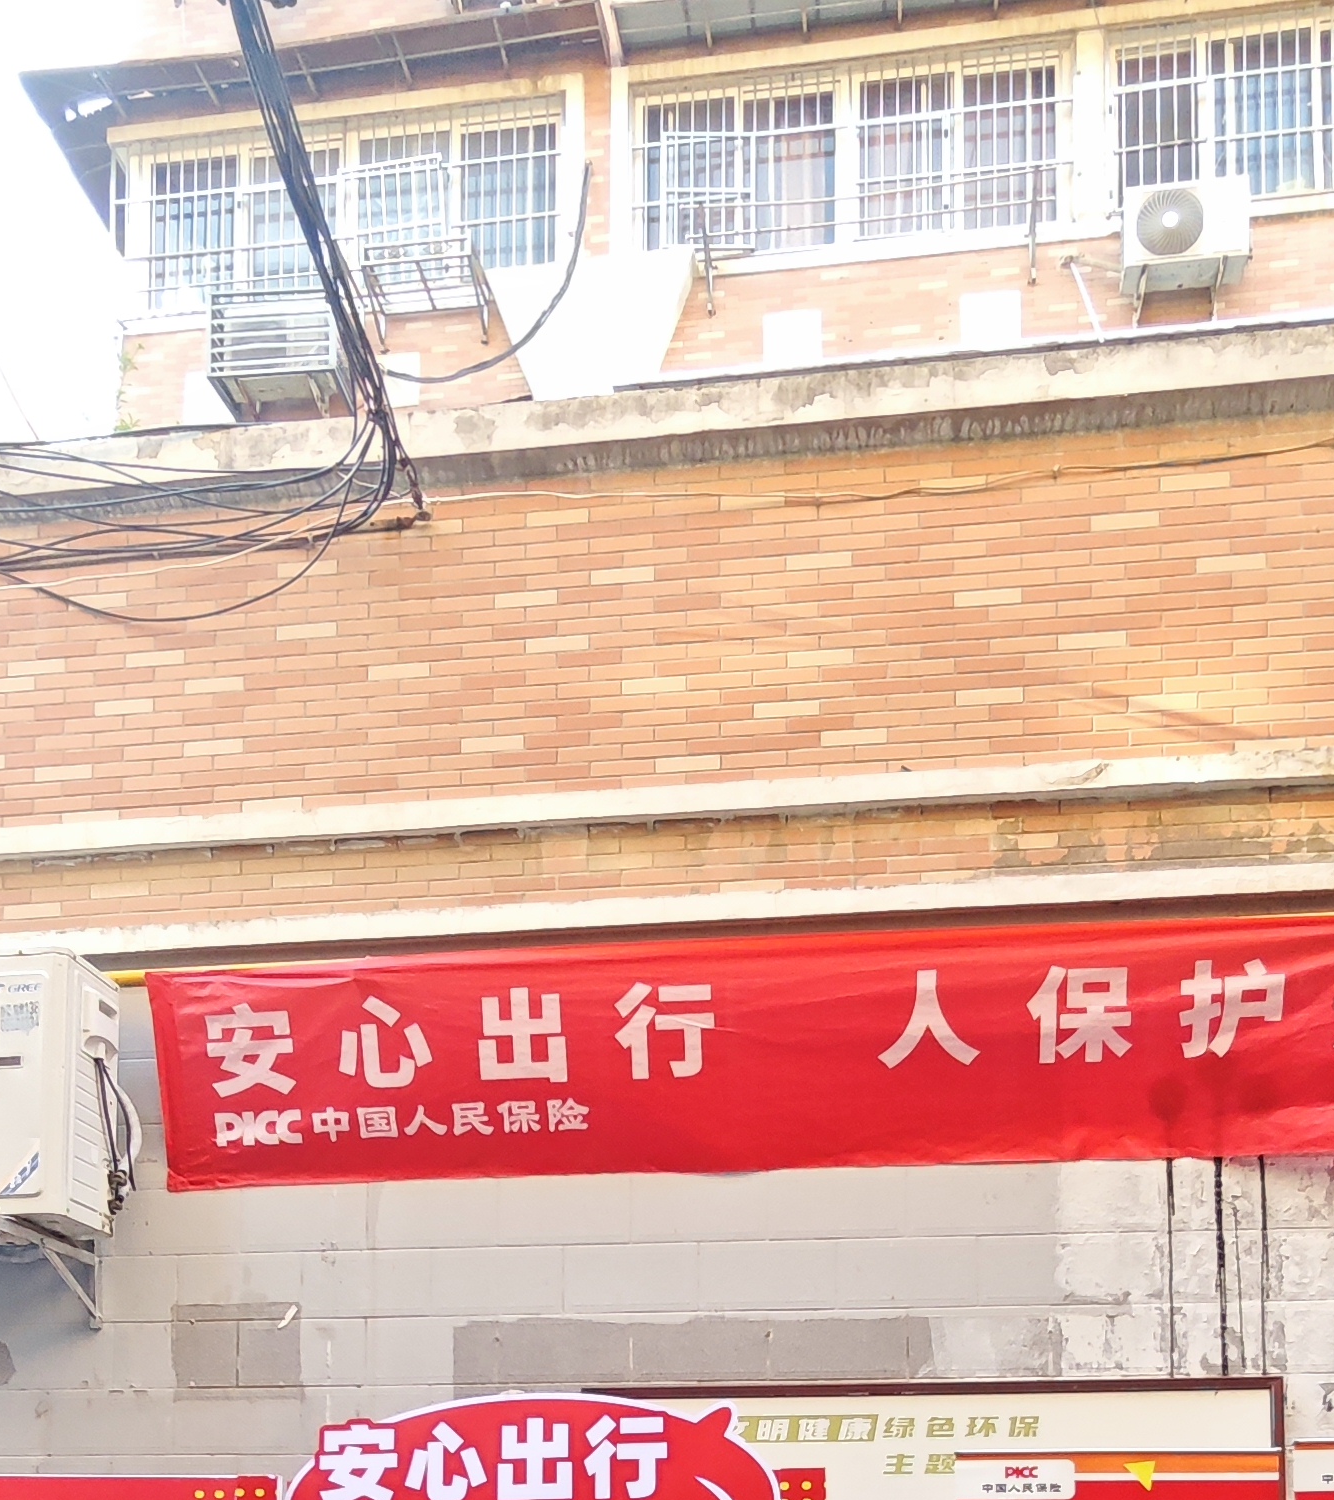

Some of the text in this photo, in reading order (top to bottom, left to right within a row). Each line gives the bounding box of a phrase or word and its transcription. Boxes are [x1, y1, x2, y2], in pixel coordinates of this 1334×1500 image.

[206, 982, 715, 1099] 安心出行
[214, 1097, 590, 1147] PICC 中国人民保险
[1004, 1466, 1039, 1478] PICC
[981, 1483, 1062, 1493] 中国人民保险
